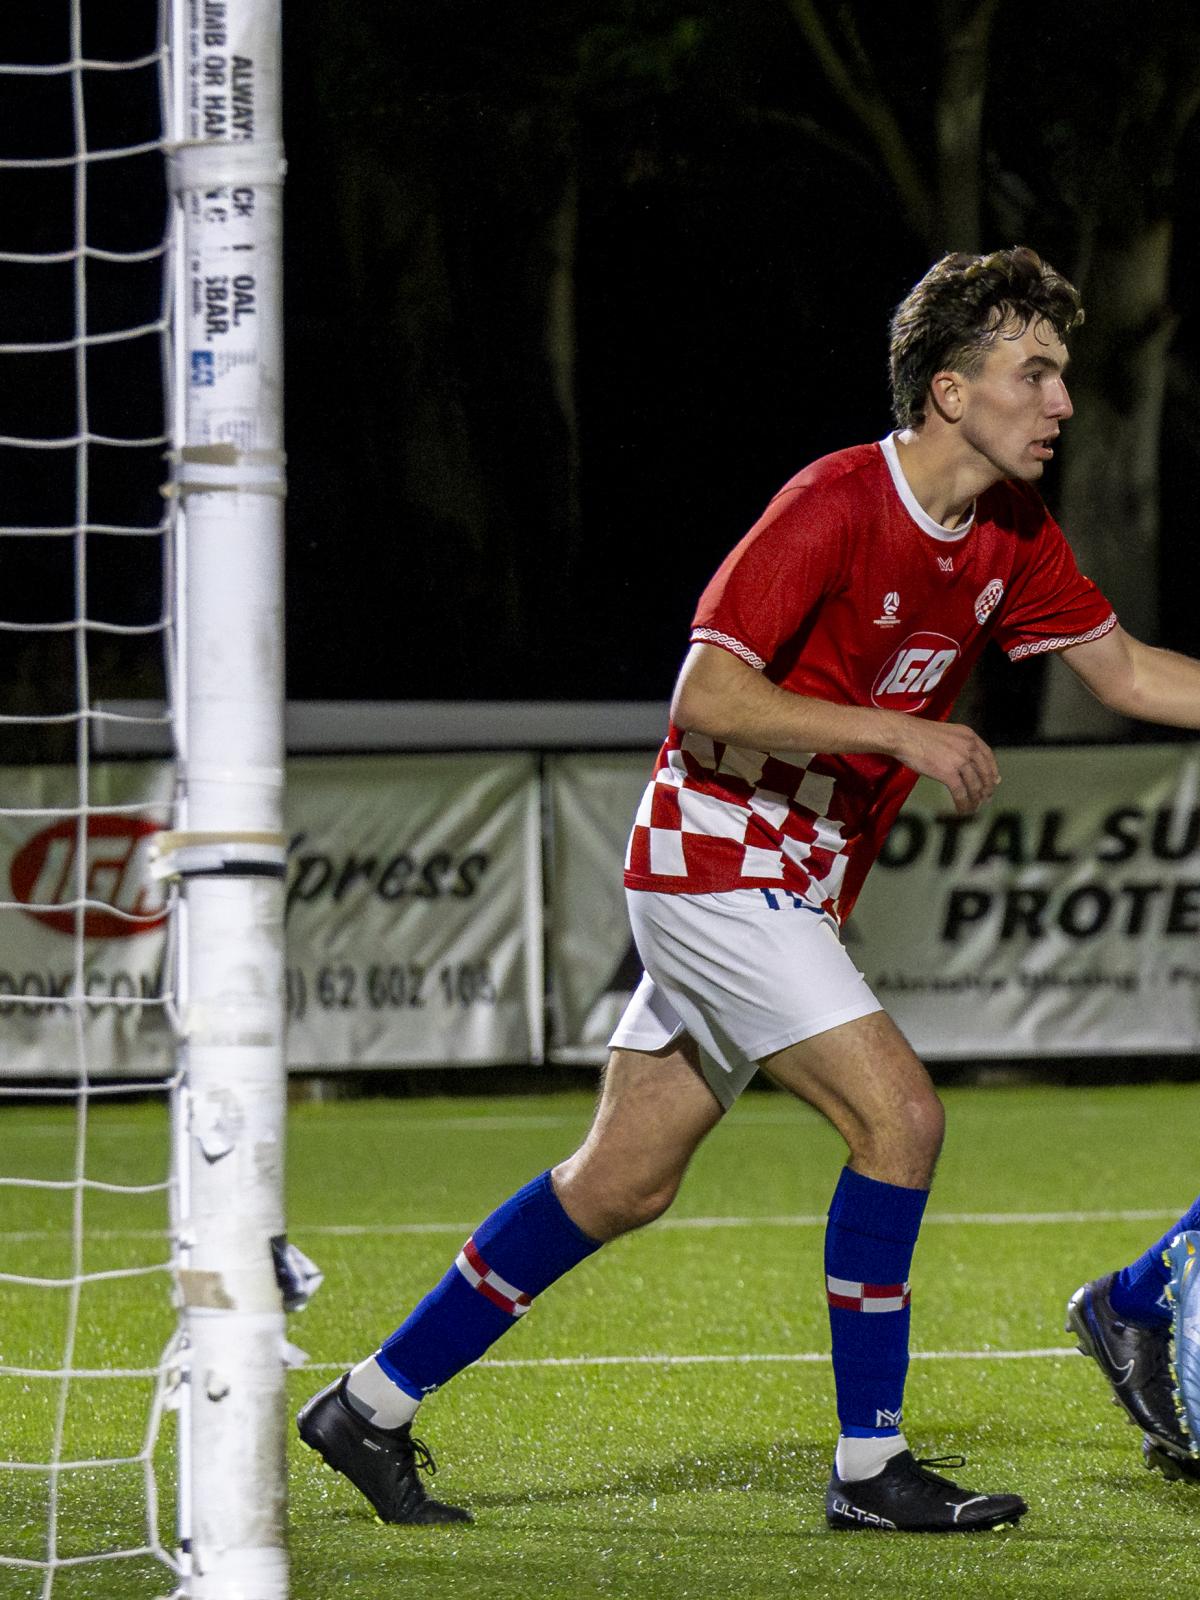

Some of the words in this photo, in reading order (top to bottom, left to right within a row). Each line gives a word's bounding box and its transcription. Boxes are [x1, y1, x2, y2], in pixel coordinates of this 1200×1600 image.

[204, 0, 227, 47] IMB
[204, 56, 227, 86] OR
[204, 276, 229, 342] SBAR.
[232, 275, 256, 328] OAL.
[875, 648, 957, 696] IGA
[878, 809, 1070, 869] OTAL
[30, 836, 164, 912] IGA
[283, 834, 488, 930] press
[833, 1500, 897, 1529] ULTRA
